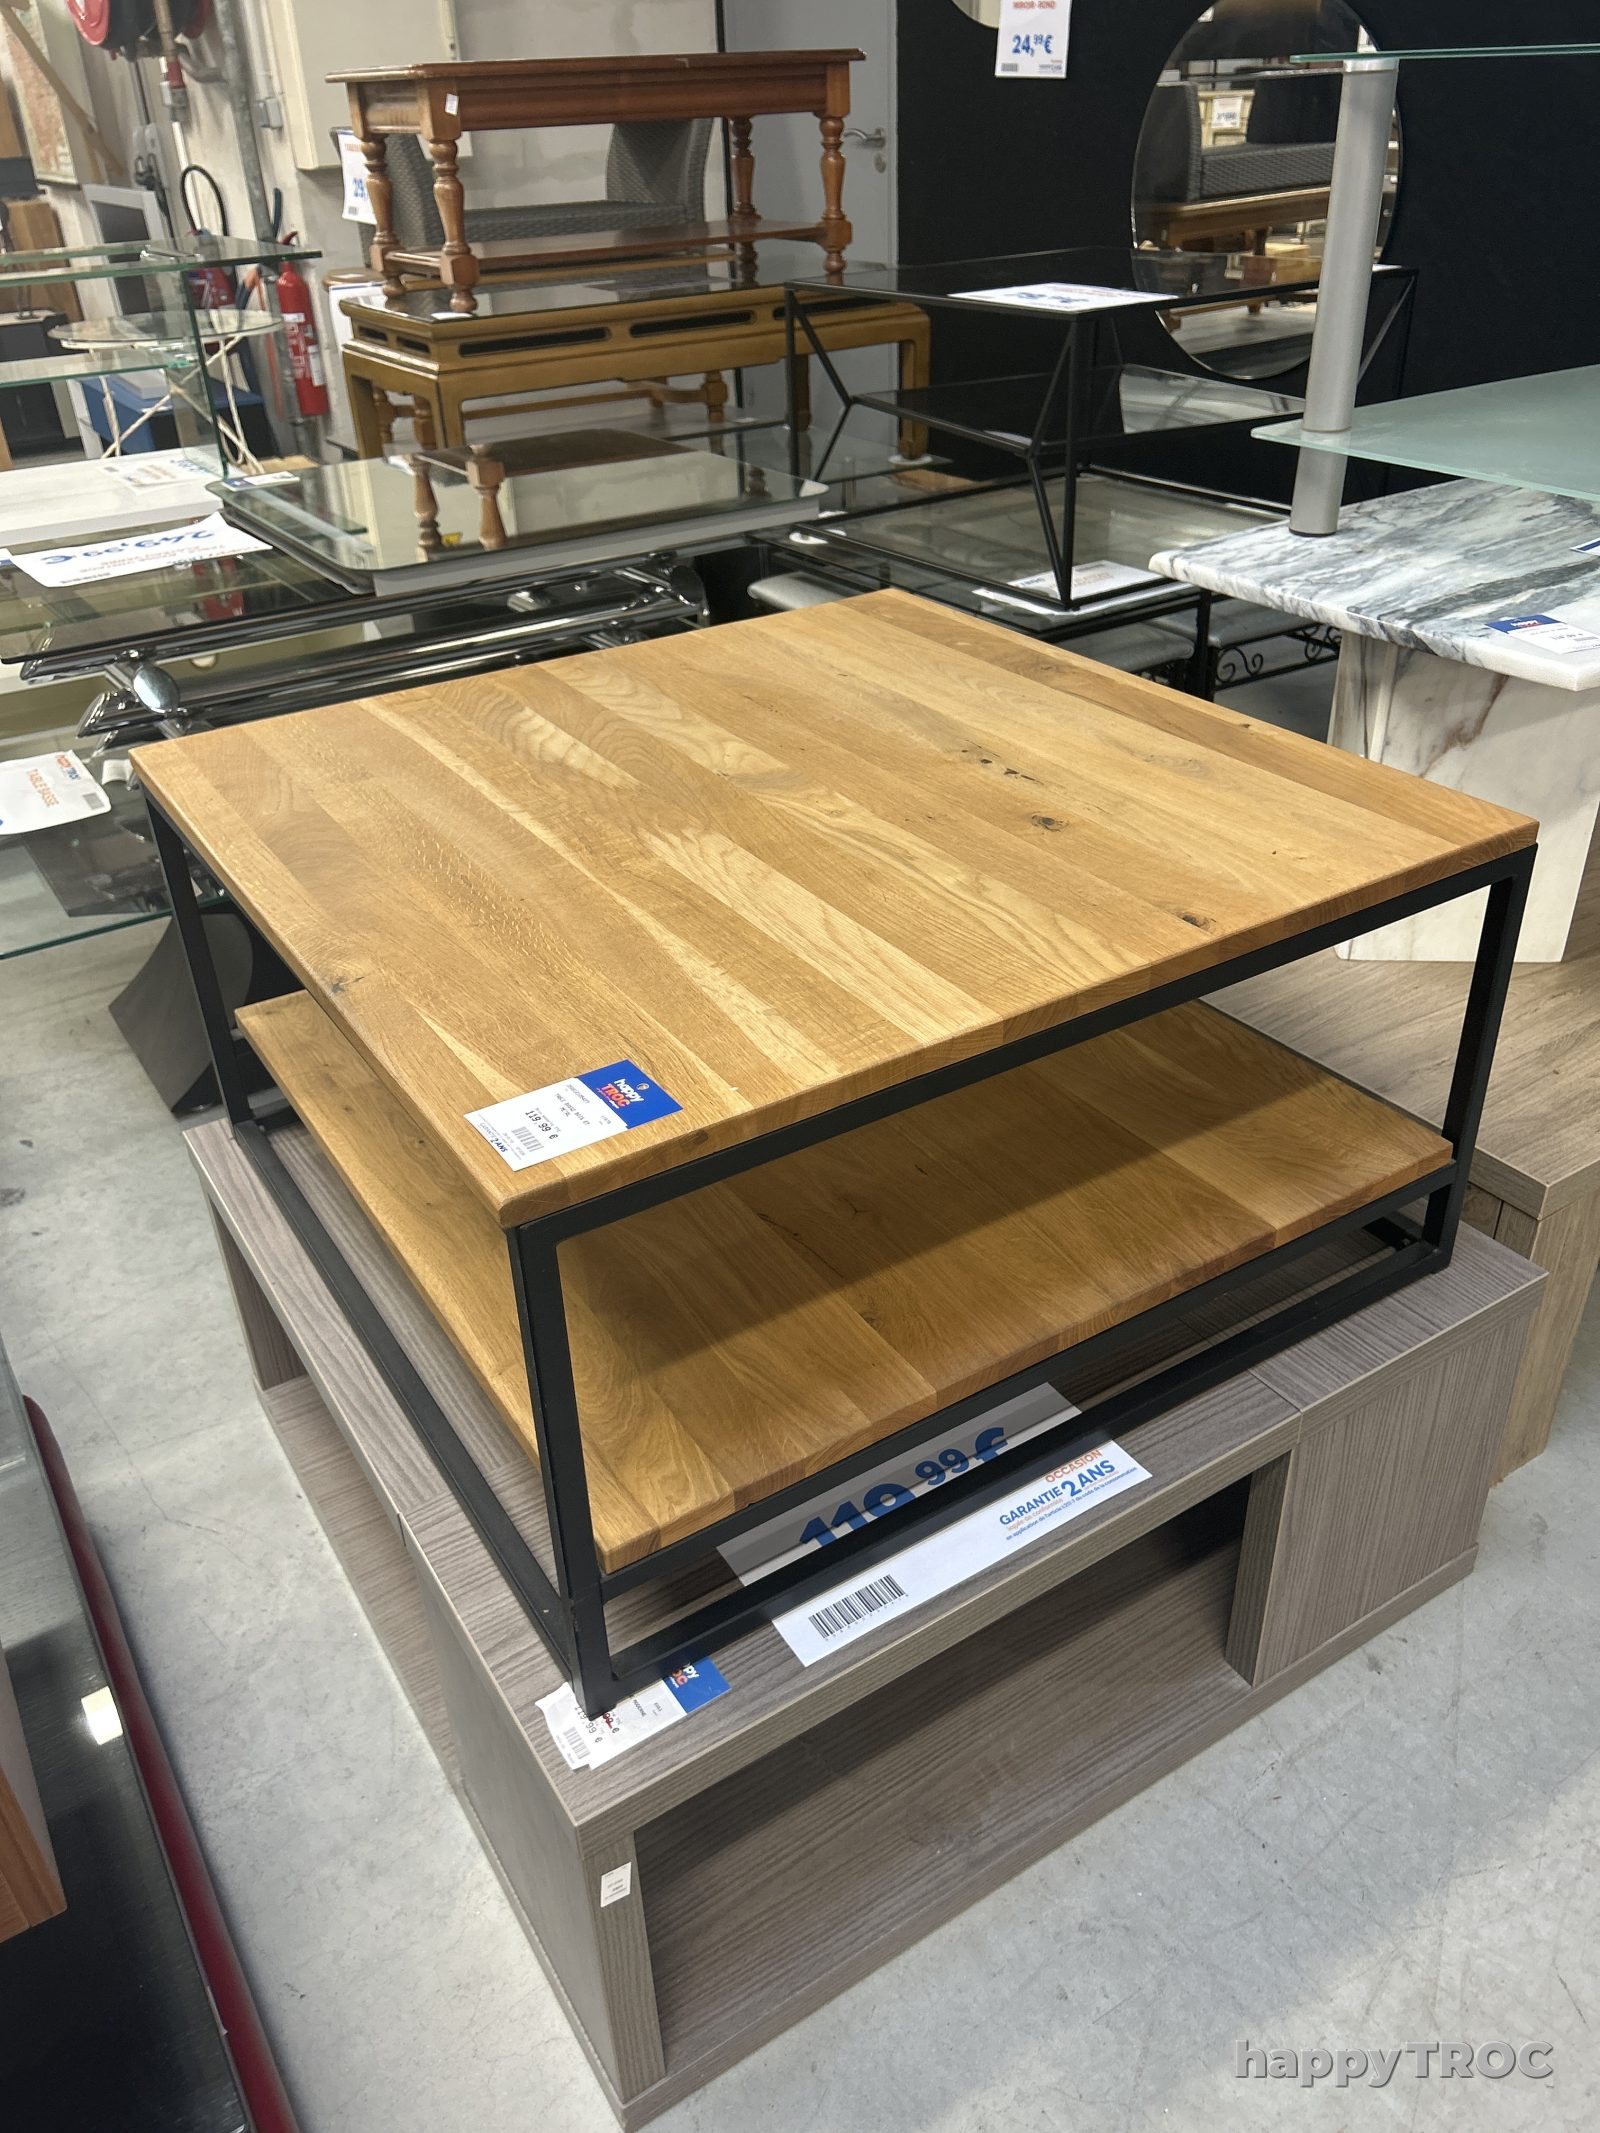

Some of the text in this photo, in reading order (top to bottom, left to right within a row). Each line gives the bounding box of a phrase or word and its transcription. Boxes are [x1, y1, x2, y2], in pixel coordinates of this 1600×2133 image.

[602, 1083, 631, 1107] TROC
[614, 1078, 644, 1102] happy
[1045, 1449, 1103, 1483] OCCASION
[1000, 1486, 1063, 1526] GARANTIE
[1061, 1480, 1082, 1497] 2
[1078, 1459, 1115, 1488] ANS
